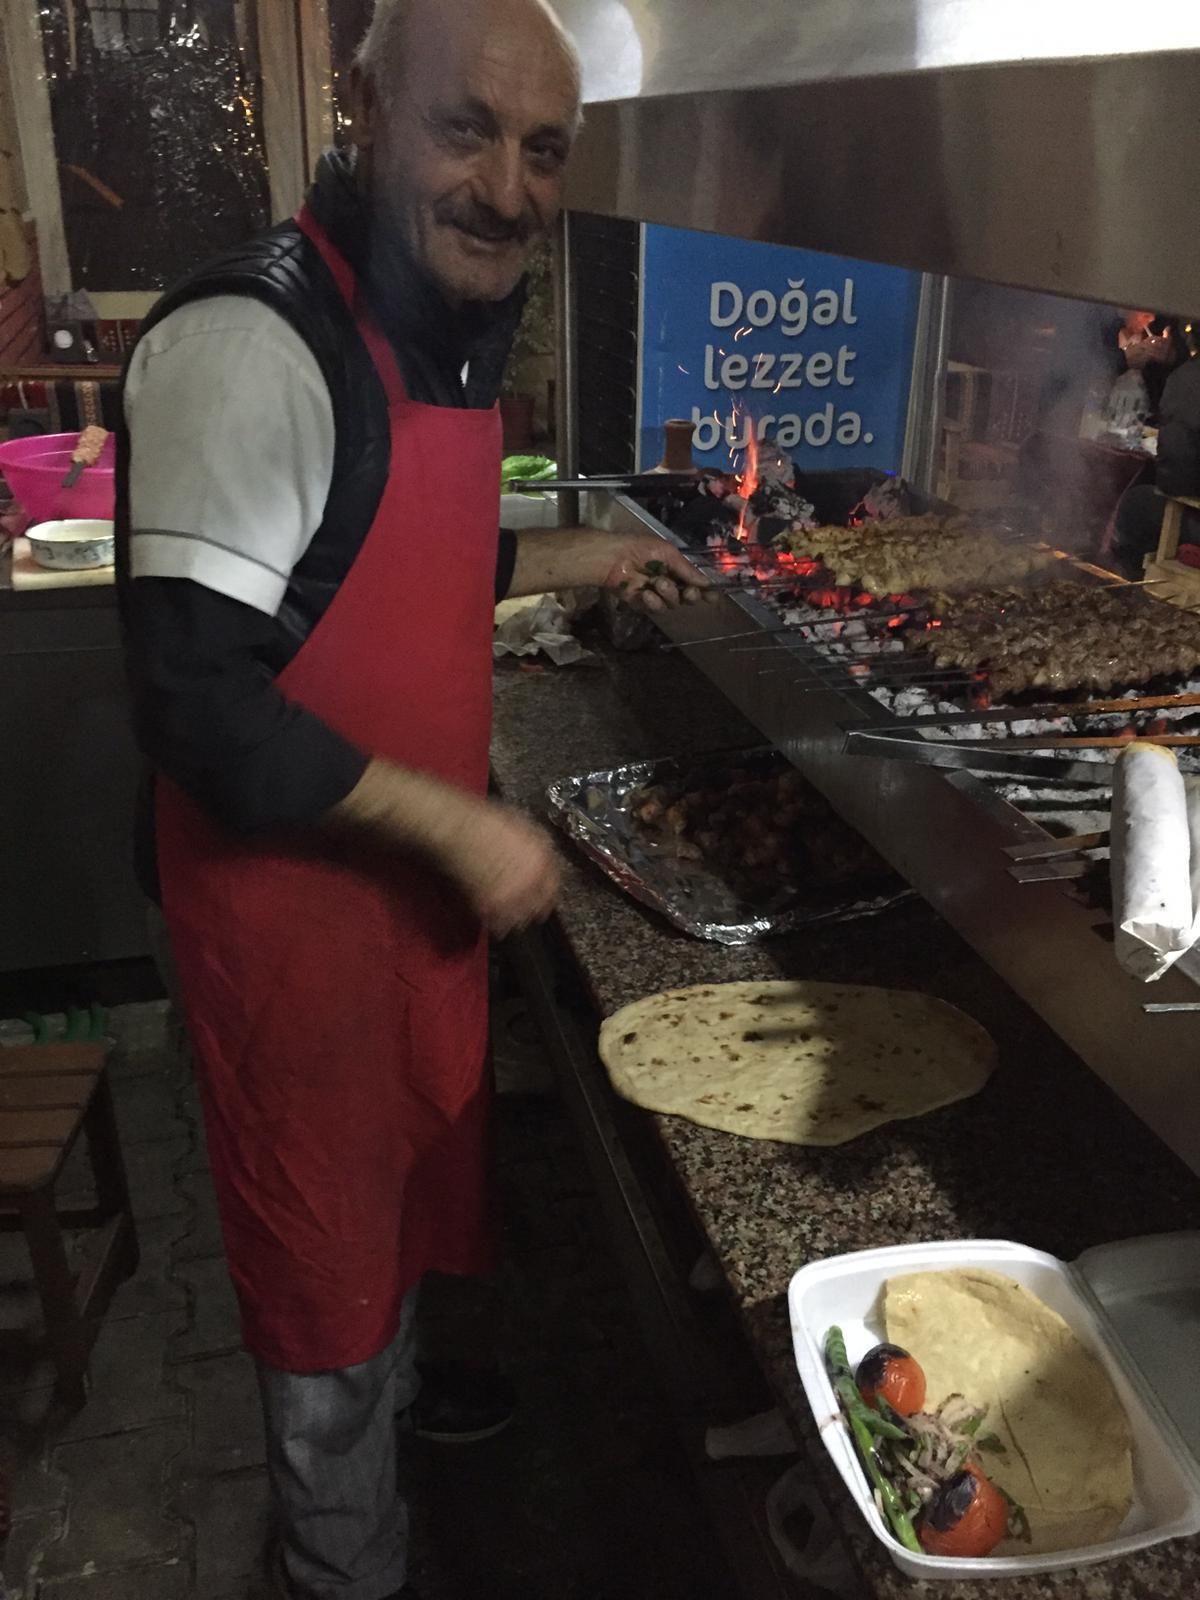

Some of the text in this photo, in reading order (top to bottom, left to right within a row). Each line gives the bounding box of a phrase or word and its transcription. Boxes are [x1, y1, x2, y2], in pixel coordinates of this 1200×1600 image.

[709, 277, 858, 336] Doğal
[703, 344, 857, 390] lezzet
[691, 401, 874, 450] burada.
